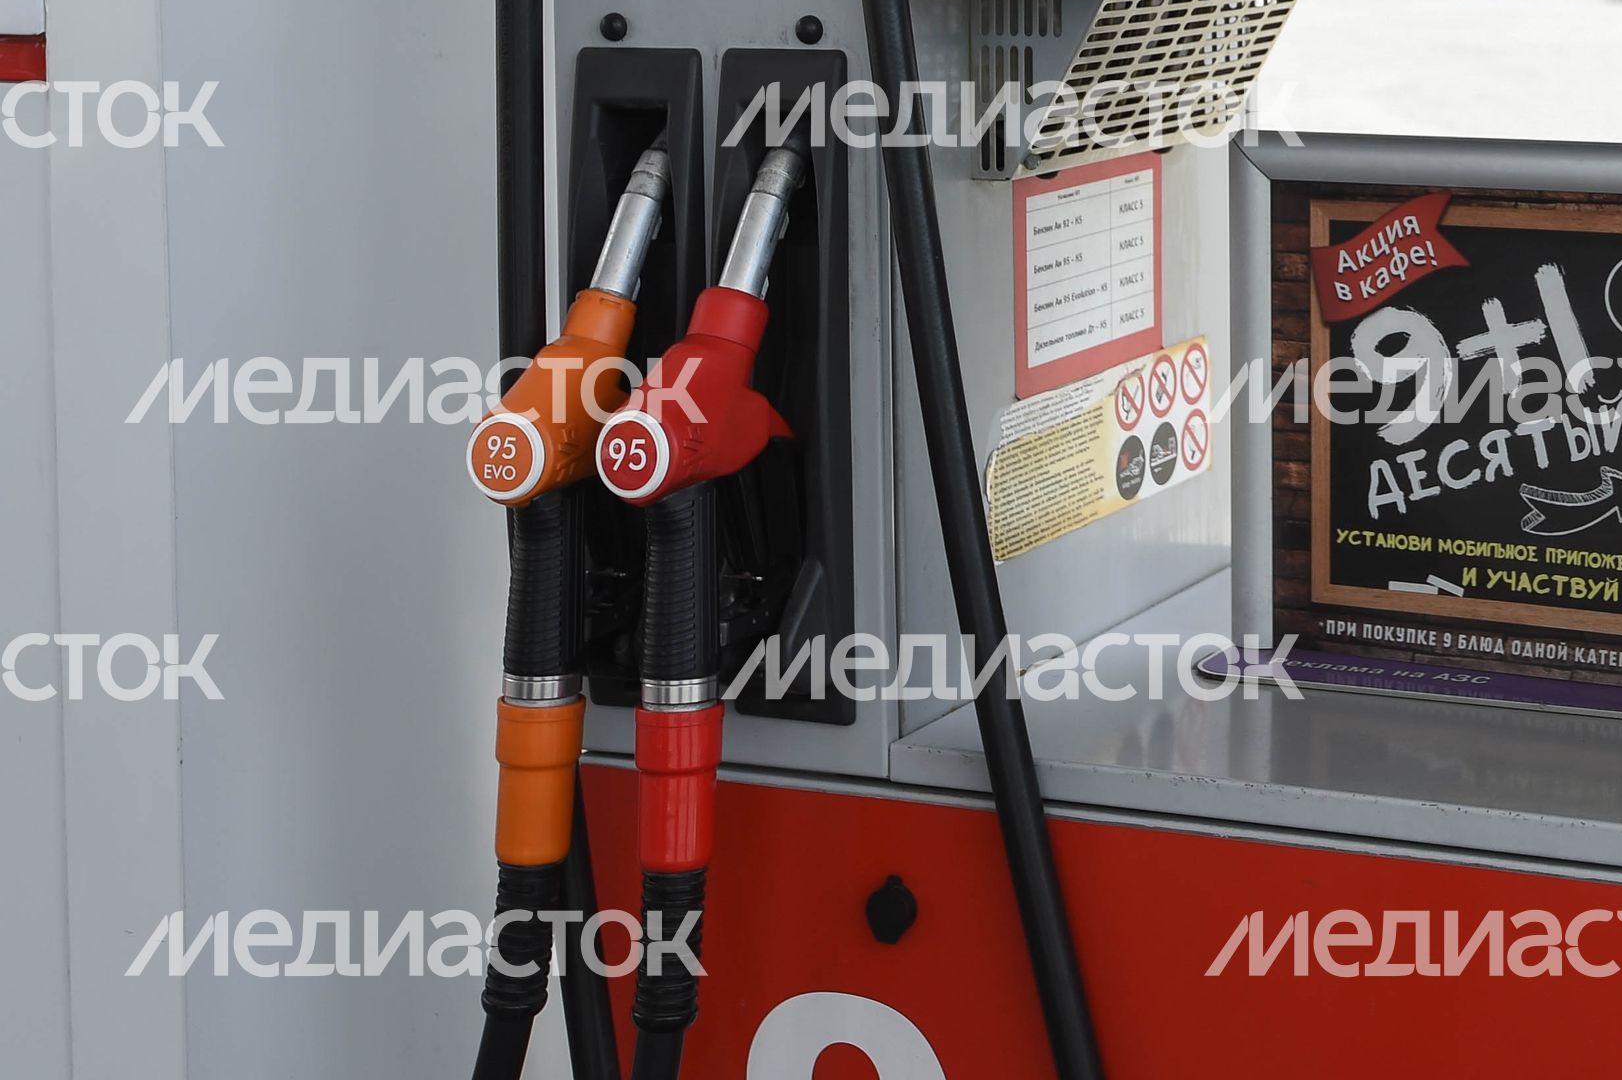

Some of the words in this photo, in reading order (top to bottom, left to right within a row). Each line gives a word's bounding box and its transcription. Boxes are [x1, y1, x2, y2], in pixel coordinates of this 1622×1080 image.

[1119, 201, 1139, 215] КЛАСС
[1139, 199, 1144, 210] 5
[1119, 237, 1139, 251] КЛАСС
[1140, 236, 1144, 246] 5
[1337, 215, 1421, 274] Акция
[1120, 274, 1139, 288] КЛАСС
[1140, 272, 1144, 281] 5
[1334, 281, 1353, 302] в
[1360, 240, 1438, 300] кафе!
[1071, 287, 1096, 302] Evolution
[1120, 310, 1139, 324] КЛАСС
[1140, 308, 1145, 318] 5
[487, 435, 517, 460] 95
[608, 437, 647, 472] 95
[483, 464, 517, 481] EVO
[1336, 528, 1432, 553] УСТАНОВИ
[1438, 538, 1538, 563] МОБИЛЬНОЕ
[1462, 567, 1478, 587] И
[1486, 569, 1619, 603] УЧАСТВУЙ
[1362, 623, 1437, 647] ПОКУПКЕ
[1443, 632, 1452, 648] 9
[1458, 634, 1505, 656] БЛЮД
[1511, 639, 1568, 660] ОДНОЙ
[1390, 670, 1426, 680] на
[1433, 672, 1492, 686] АЗС
